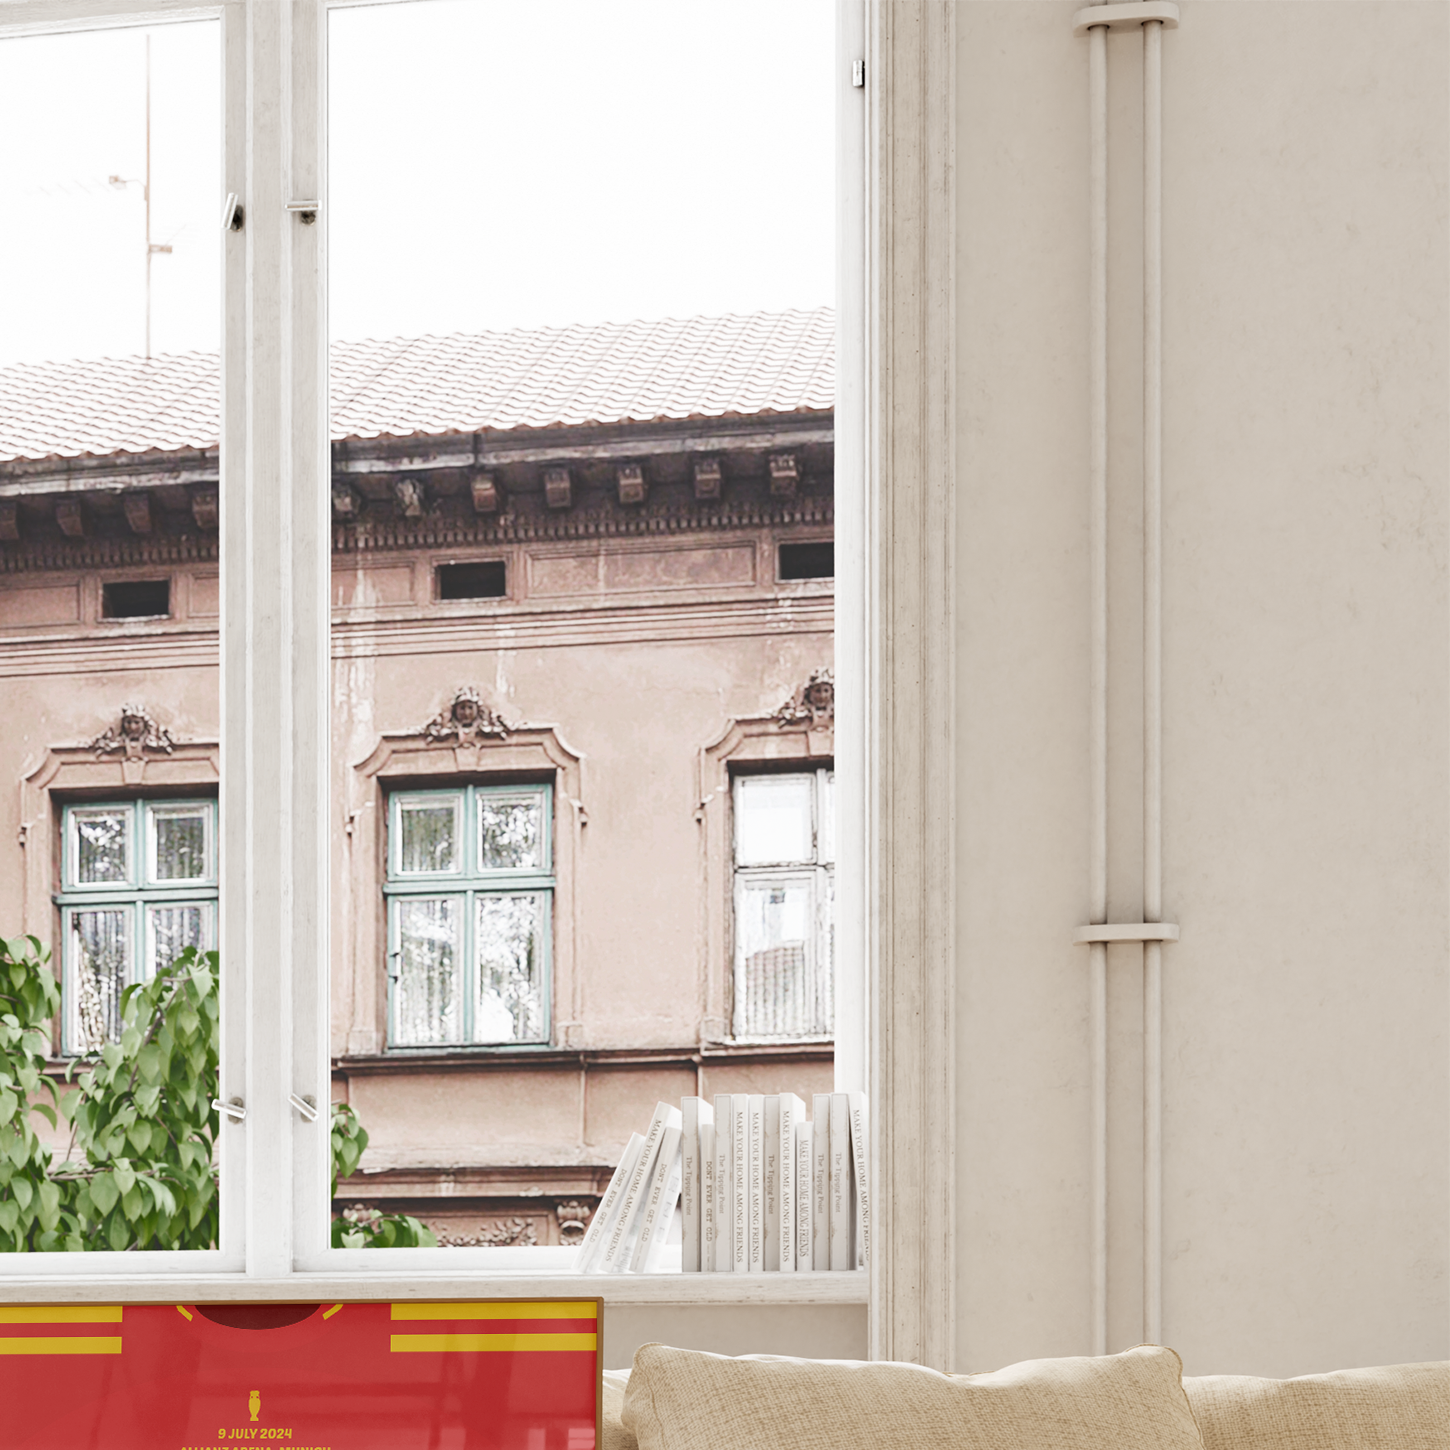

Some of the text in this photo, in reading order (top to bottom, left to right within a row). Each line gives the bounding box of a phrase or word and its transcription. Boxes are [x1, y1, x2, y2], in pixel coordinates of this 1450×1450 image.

[855, 1135, 863, 1160] YOUR
[767, 1170, 775, 1195] Tipping
[816, 1169, 824, 1194] Tipping
[834, 1168, 842, 1193] Tipping
[858, 1161, 866, 1188] HOME
[606, 1119, 661, 1262] MAKE YOUR HOME AMONG FRIENDS
[641, 1163, 667, 1242] DONT EVER GET OLD
[799, 1140, 809, 1257] MAKE YOUR HOME AMONG FRIENDS
[589, 1168, 627, 1243] DONT EVER GET OLD
[860, 1190, 868, 1222] AMONG
[218, 1428, 292, 1439] 9 JULY 2024
